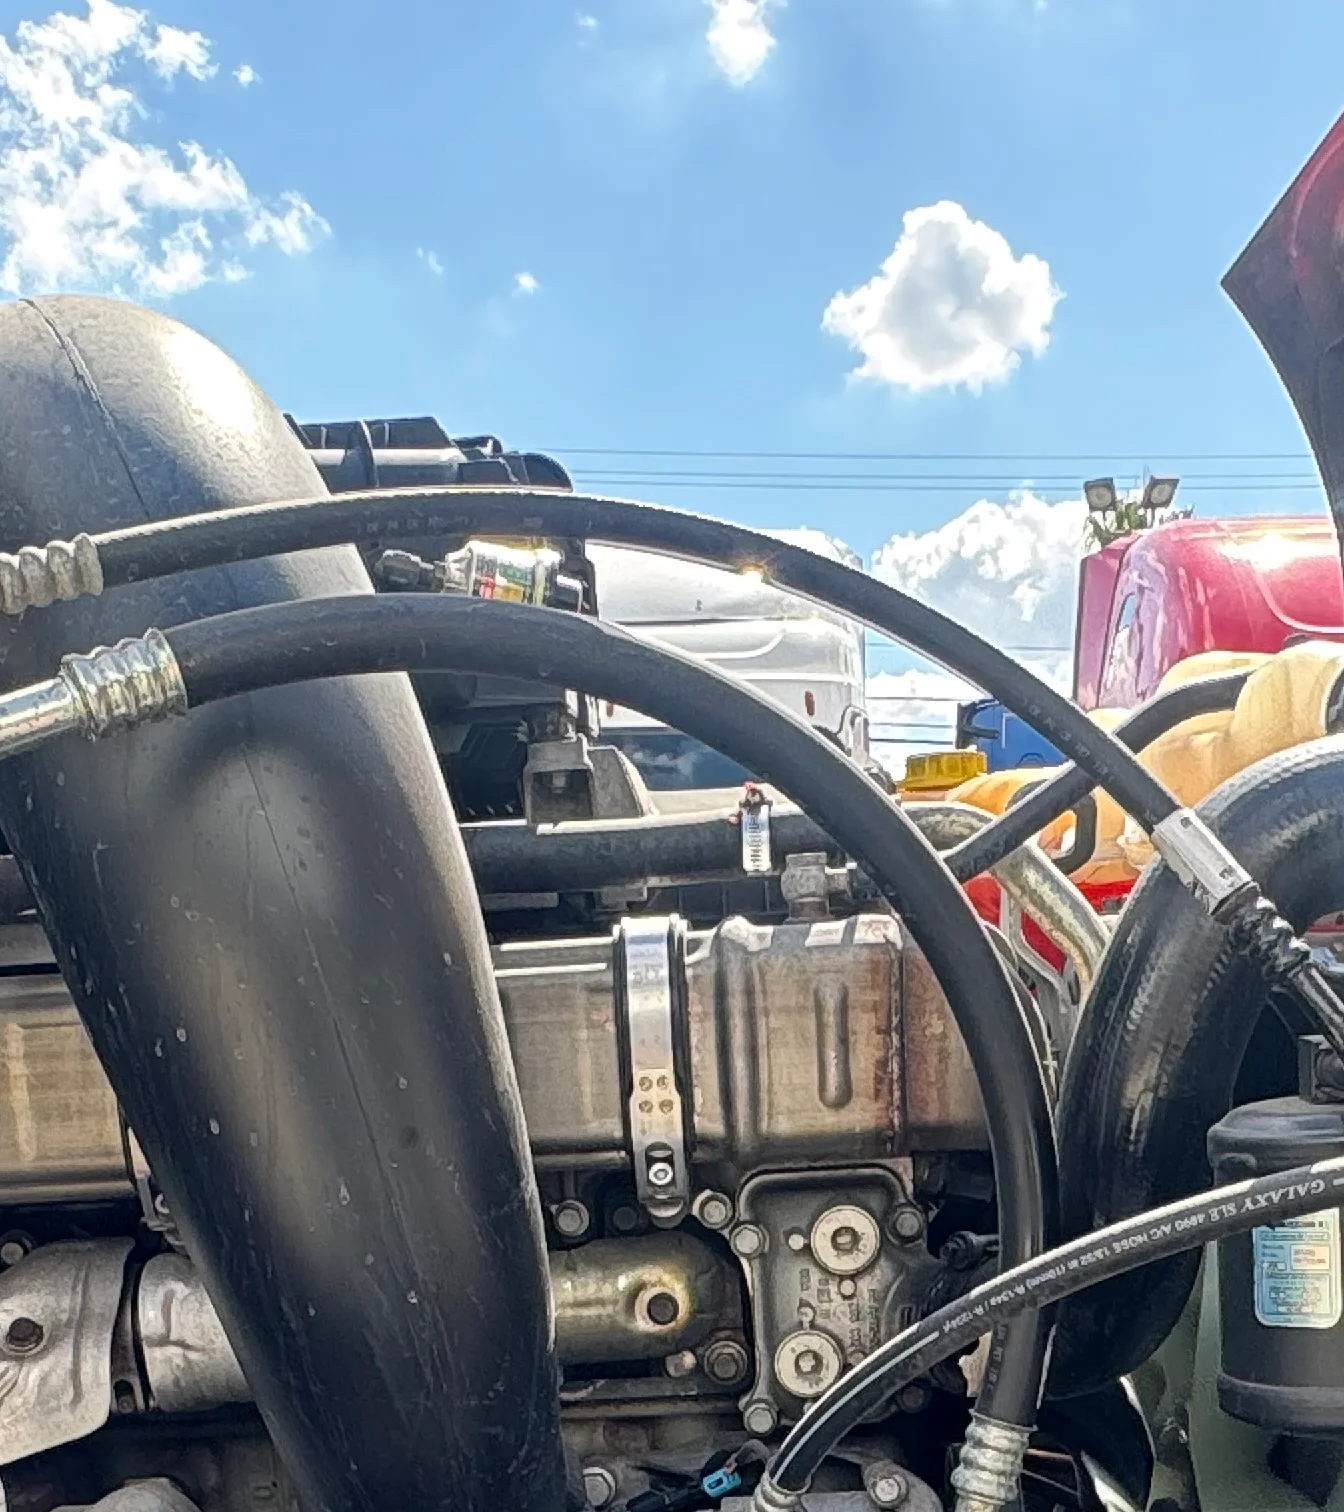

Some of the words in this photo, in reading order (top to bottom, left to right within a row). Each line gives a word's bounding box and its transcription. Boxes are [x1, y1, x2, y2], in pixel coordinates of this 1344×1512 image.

[1240, 1179, 1326, 1213] GALAXY
[1208, 1202, 1237, 1222] SLE
[1113, 1233, 1147, 1254] HOSE
[1026, 1264, 1066, 1289] (10mm)
[990, 1284, 1026, 1306] R-134a
